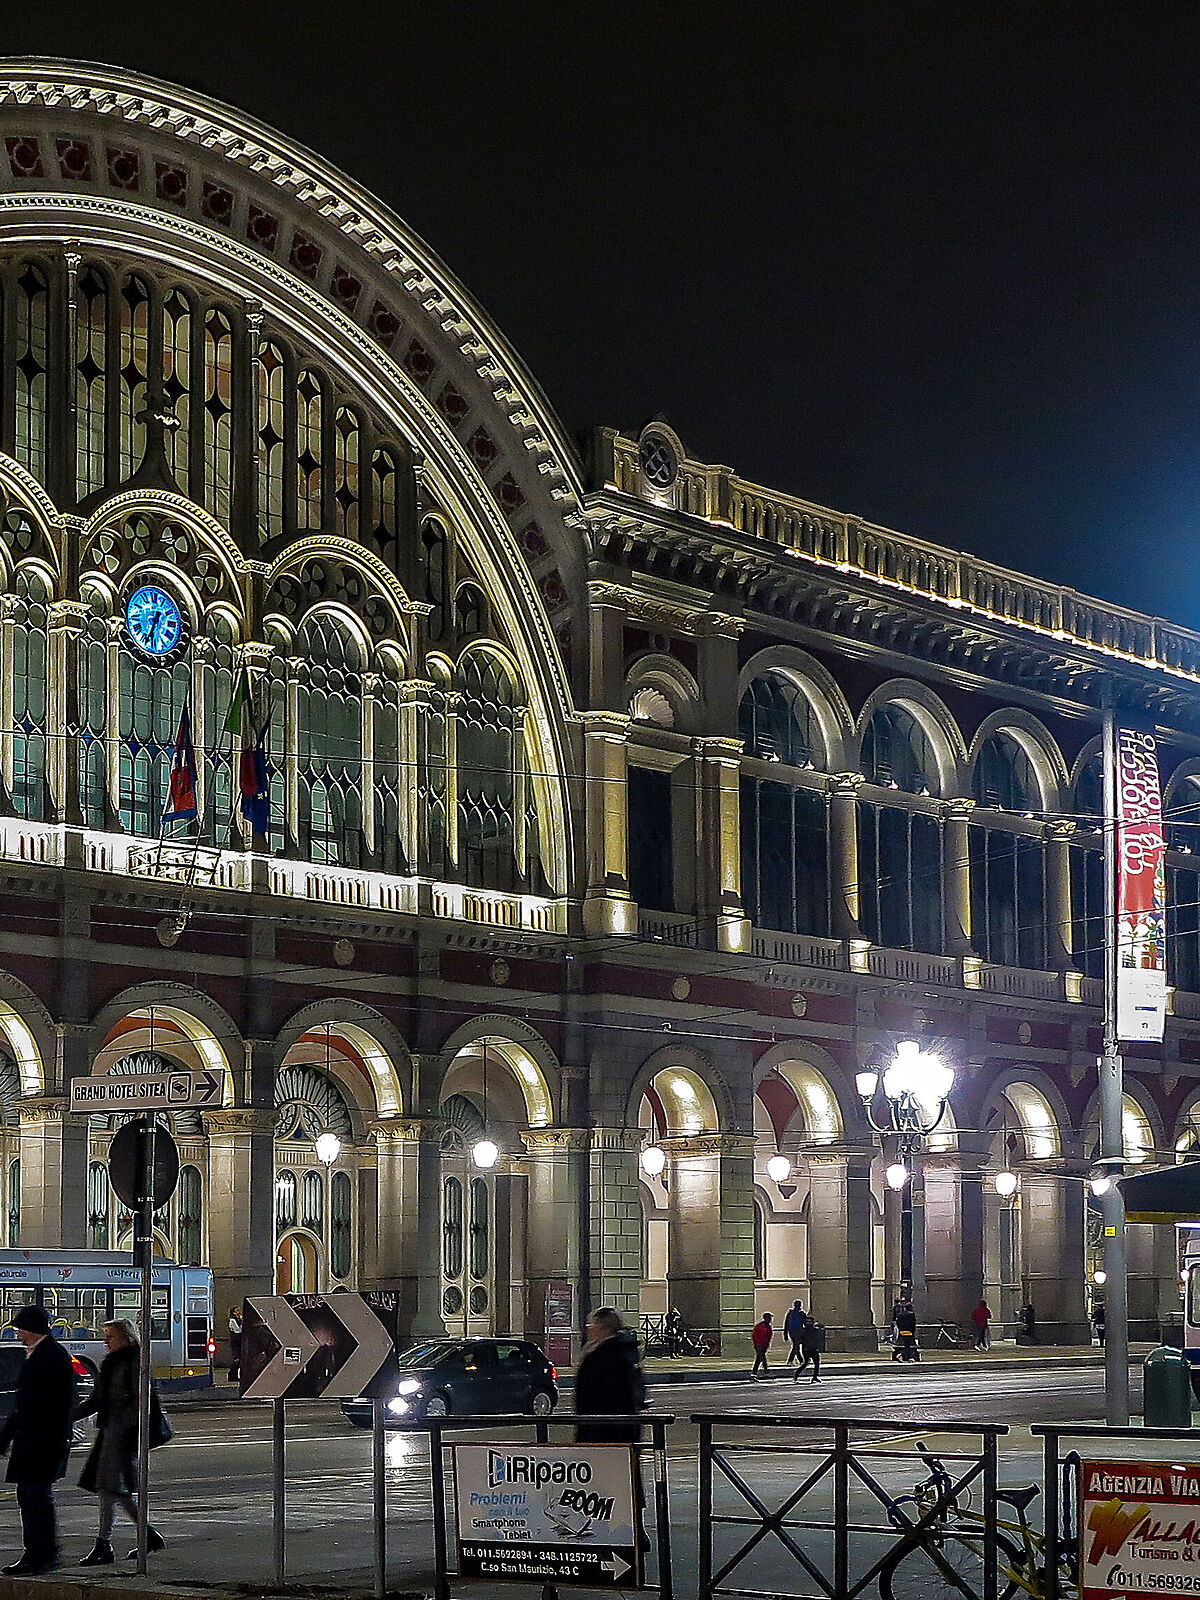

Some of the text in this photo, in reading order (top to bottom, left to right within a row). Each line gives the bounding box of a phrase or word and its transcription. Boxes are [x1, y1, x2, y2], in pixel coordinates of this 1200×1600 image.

[74, 1083, 166, 1101] GRAND HOTEL SITEA
[506, 1456, 592, 1490] iRiparo
[1089, 1472, 1164, 1495] AGENZIA
[470, 1492, 526, 1506] Problemi
[559, 1488, 616, 1521] BOOM
[472, 1518, 527, 1529] Smartphone
[503, 1530, 532, 1540] Tablet
[463, 1548, 475, 1557] Tel.
[1127, 1541, 1195, 1562] Turismo &
[481, 1562, 499, 1571] C.so
[501, 1563, 517, 1573] San
[559, 1566, 571, 1575] 43
[572, 1567, 580, 1576] C
